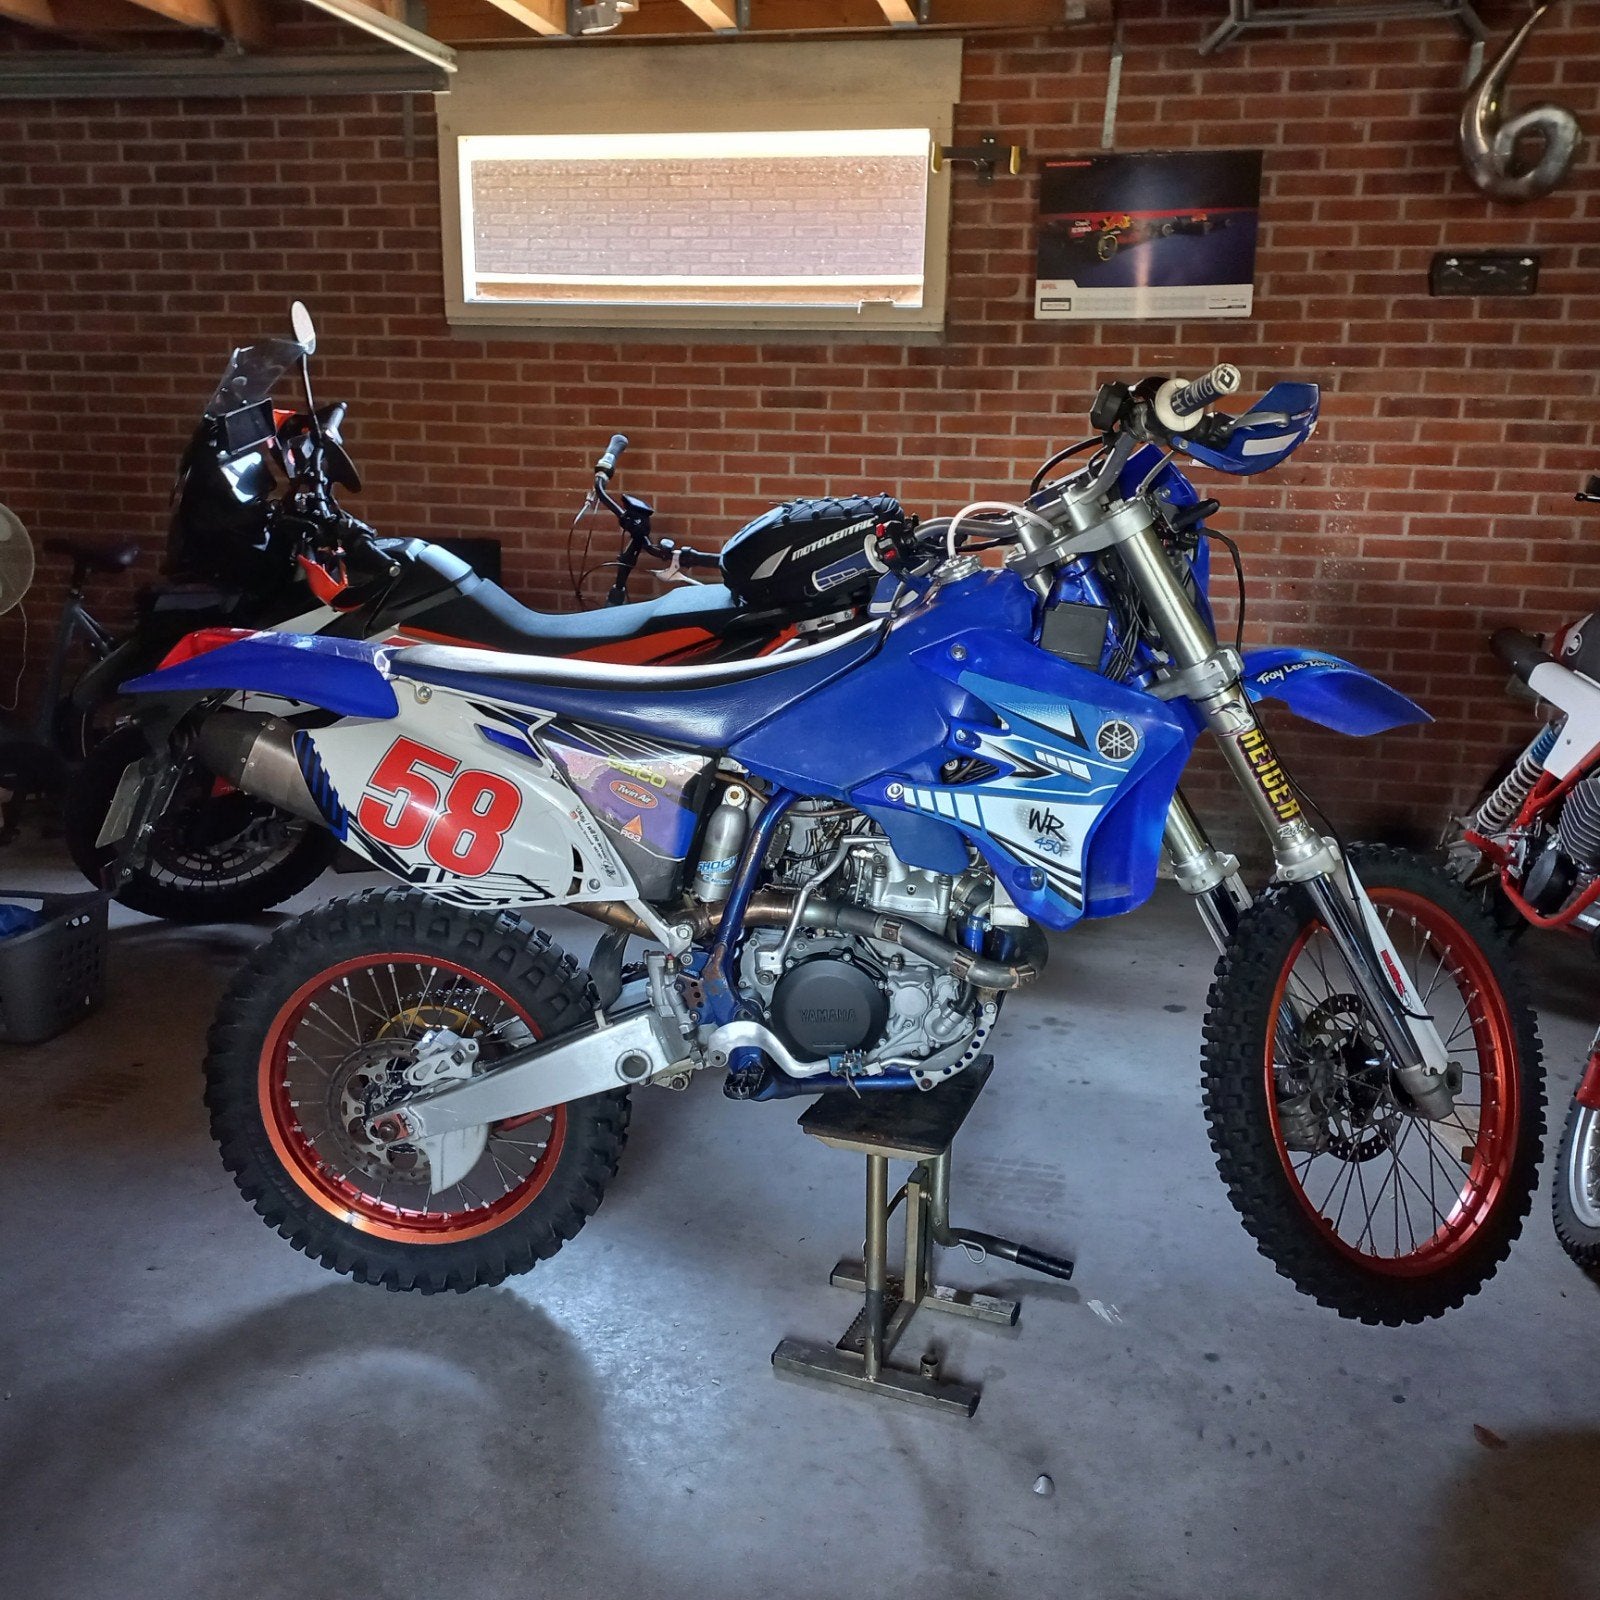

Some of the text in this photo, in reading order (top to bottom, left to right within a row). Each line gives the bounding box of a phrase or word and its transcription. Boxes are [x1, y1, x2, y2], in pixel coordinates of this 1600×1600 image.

[791, 517, 876, 561] MOTOCENTRIC
[1256, 669, 1285, 685] Troy
[1283, 663, 1307, 673] Lee
[1240, 729, 1301, 820] REIGER
[357, 735, 522, 878] 58
[617, 784, 652, 804] Twin Air
[620, 828, 642, 842] RG3
[1029, 807, 1067, 842] WR
